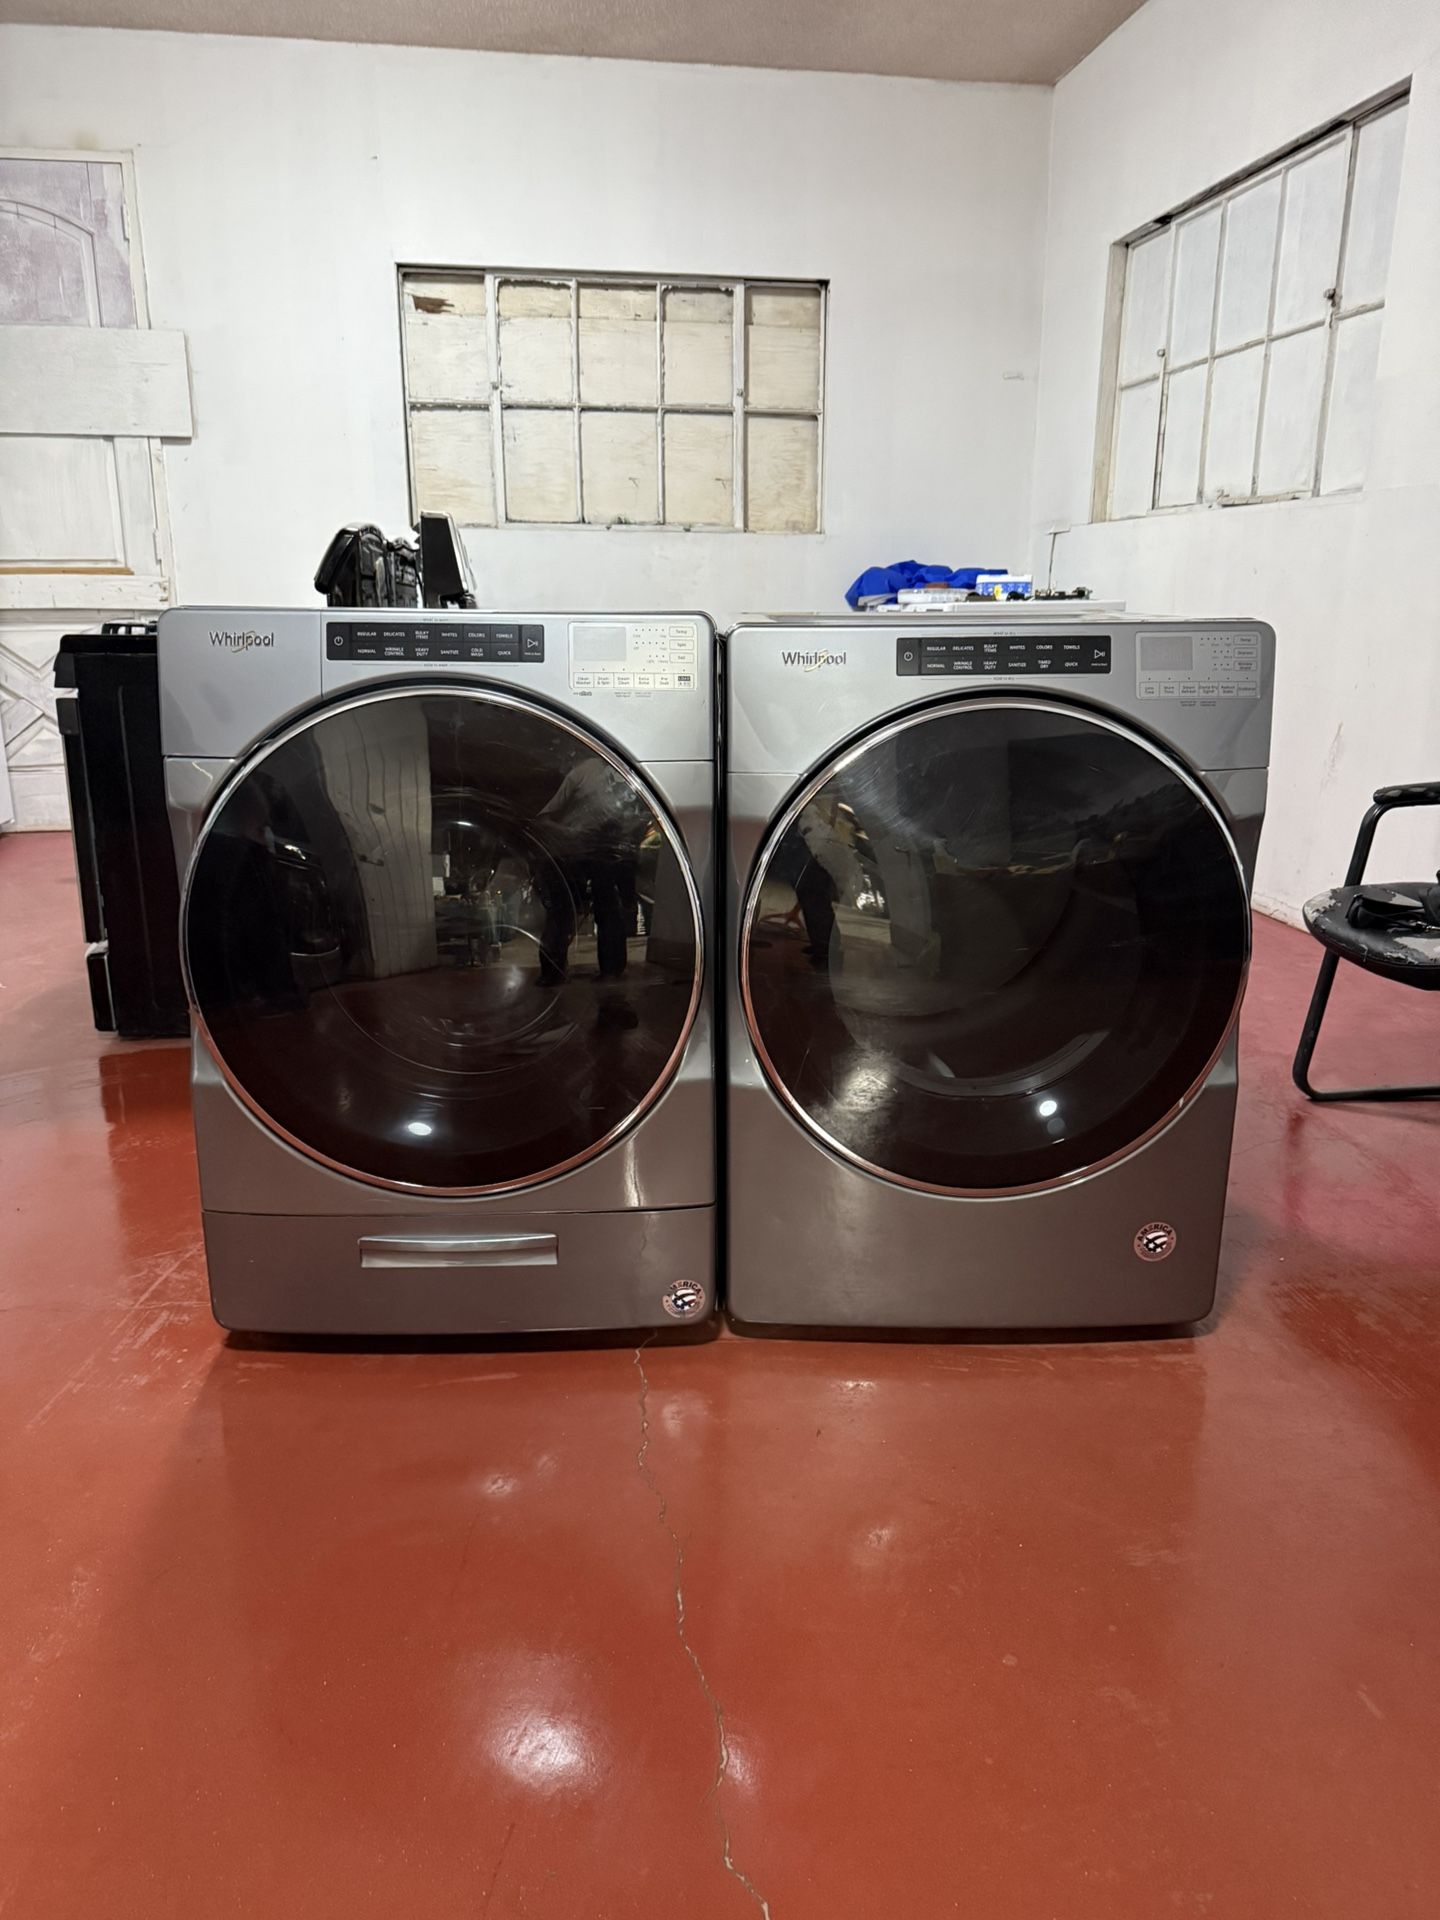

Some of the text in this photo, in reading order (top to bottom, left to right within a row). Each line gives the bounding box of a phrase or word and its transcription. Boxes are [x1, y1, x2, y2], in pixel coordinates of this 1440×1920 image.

[209, 630, 274, 651] Whirlpool
[782, 650, 847, 671] Whirlpool
[1136, 1223, 1173, 1242] AMERICA
